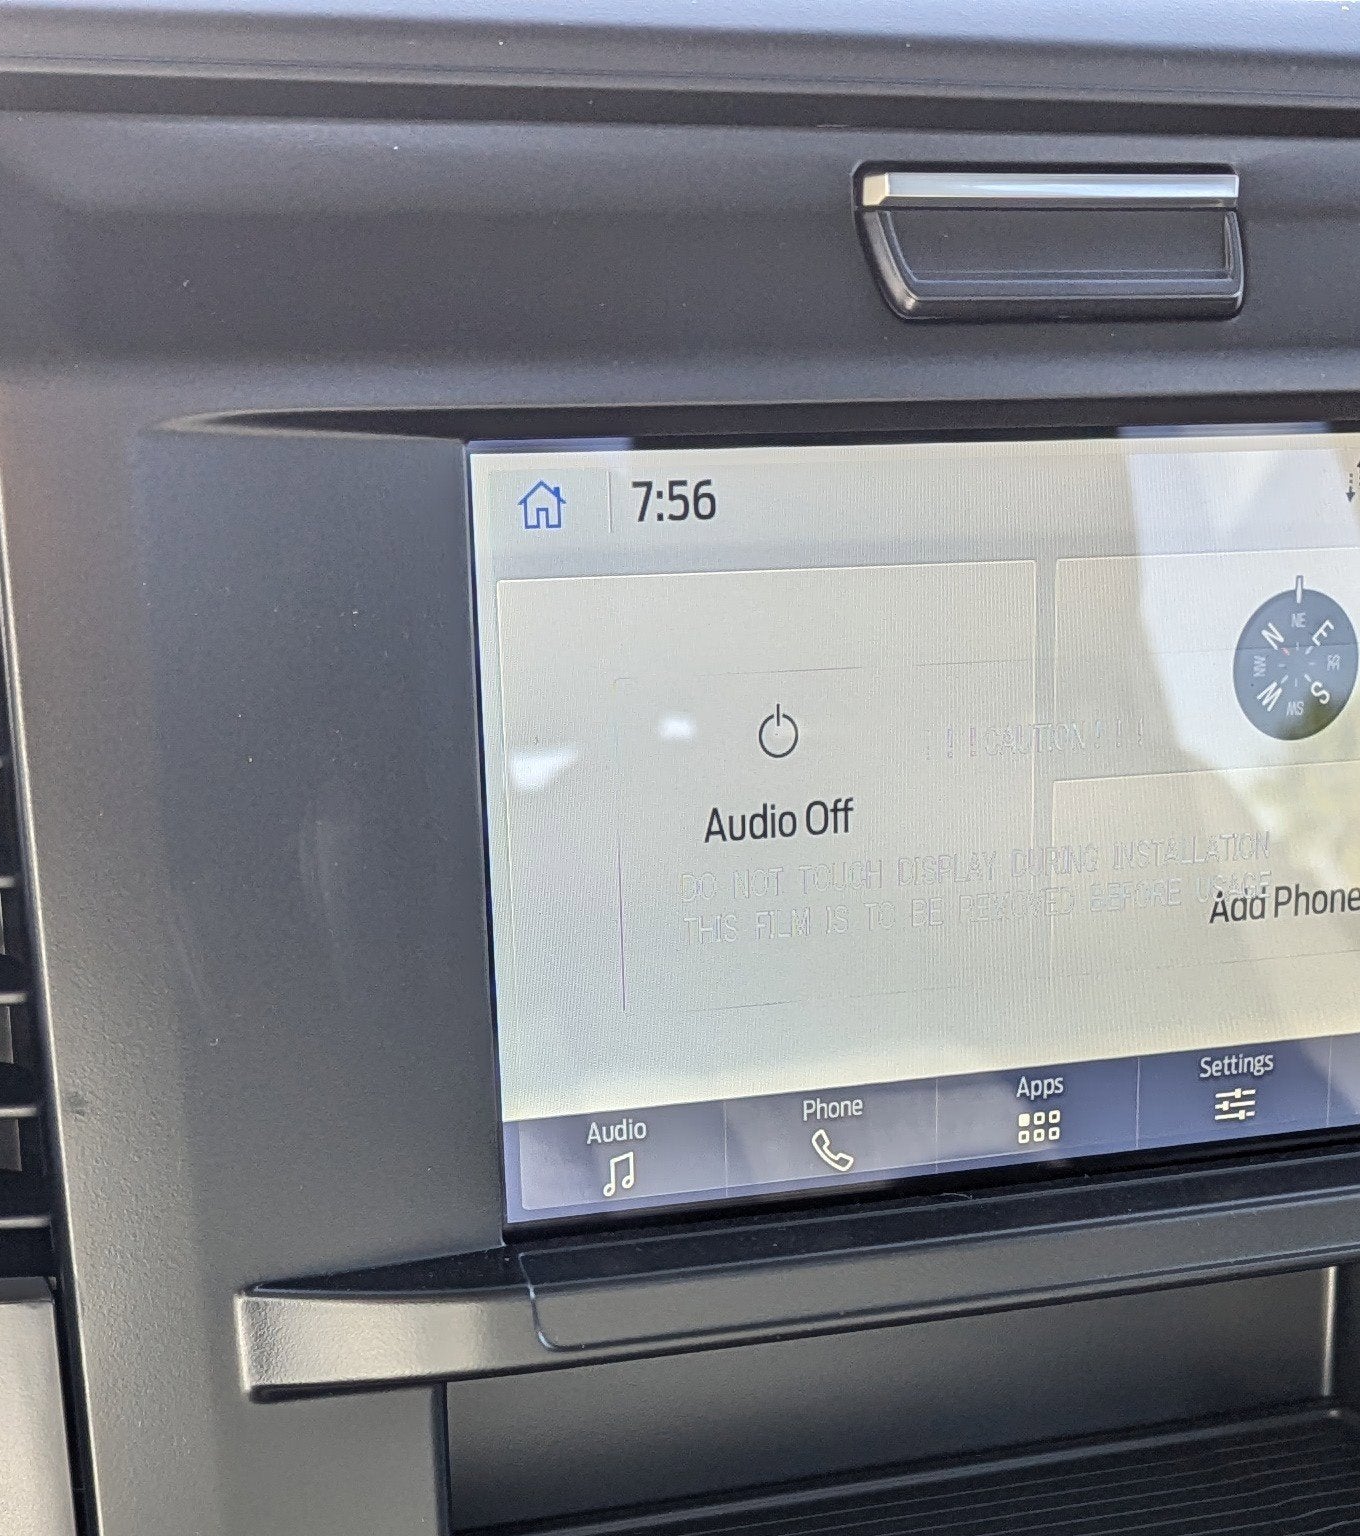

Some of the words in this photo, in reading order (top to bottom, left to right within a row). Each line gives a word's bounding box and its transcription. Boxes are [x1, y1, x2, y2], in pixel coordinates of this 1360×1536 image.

[631, 479, 717, 522] 7:56
[1260, 622, 1285, 650] N
[1312, 619, 1335, 647] E
[1256, 681, 1283, 712] W
[1310, 681, 1331, 705] S
[704, 802, 797, 843] Audio
[805, 798, 854, 836] Off
[1209, 886, 1267, 924] Add
[1199, 1053, 1274, 1078] Settings
[1016, 1075, 1064, 1101] Apps
[802, 1098, 864, 1122] Phone
[586, 1118, 647, 1145] Audio
